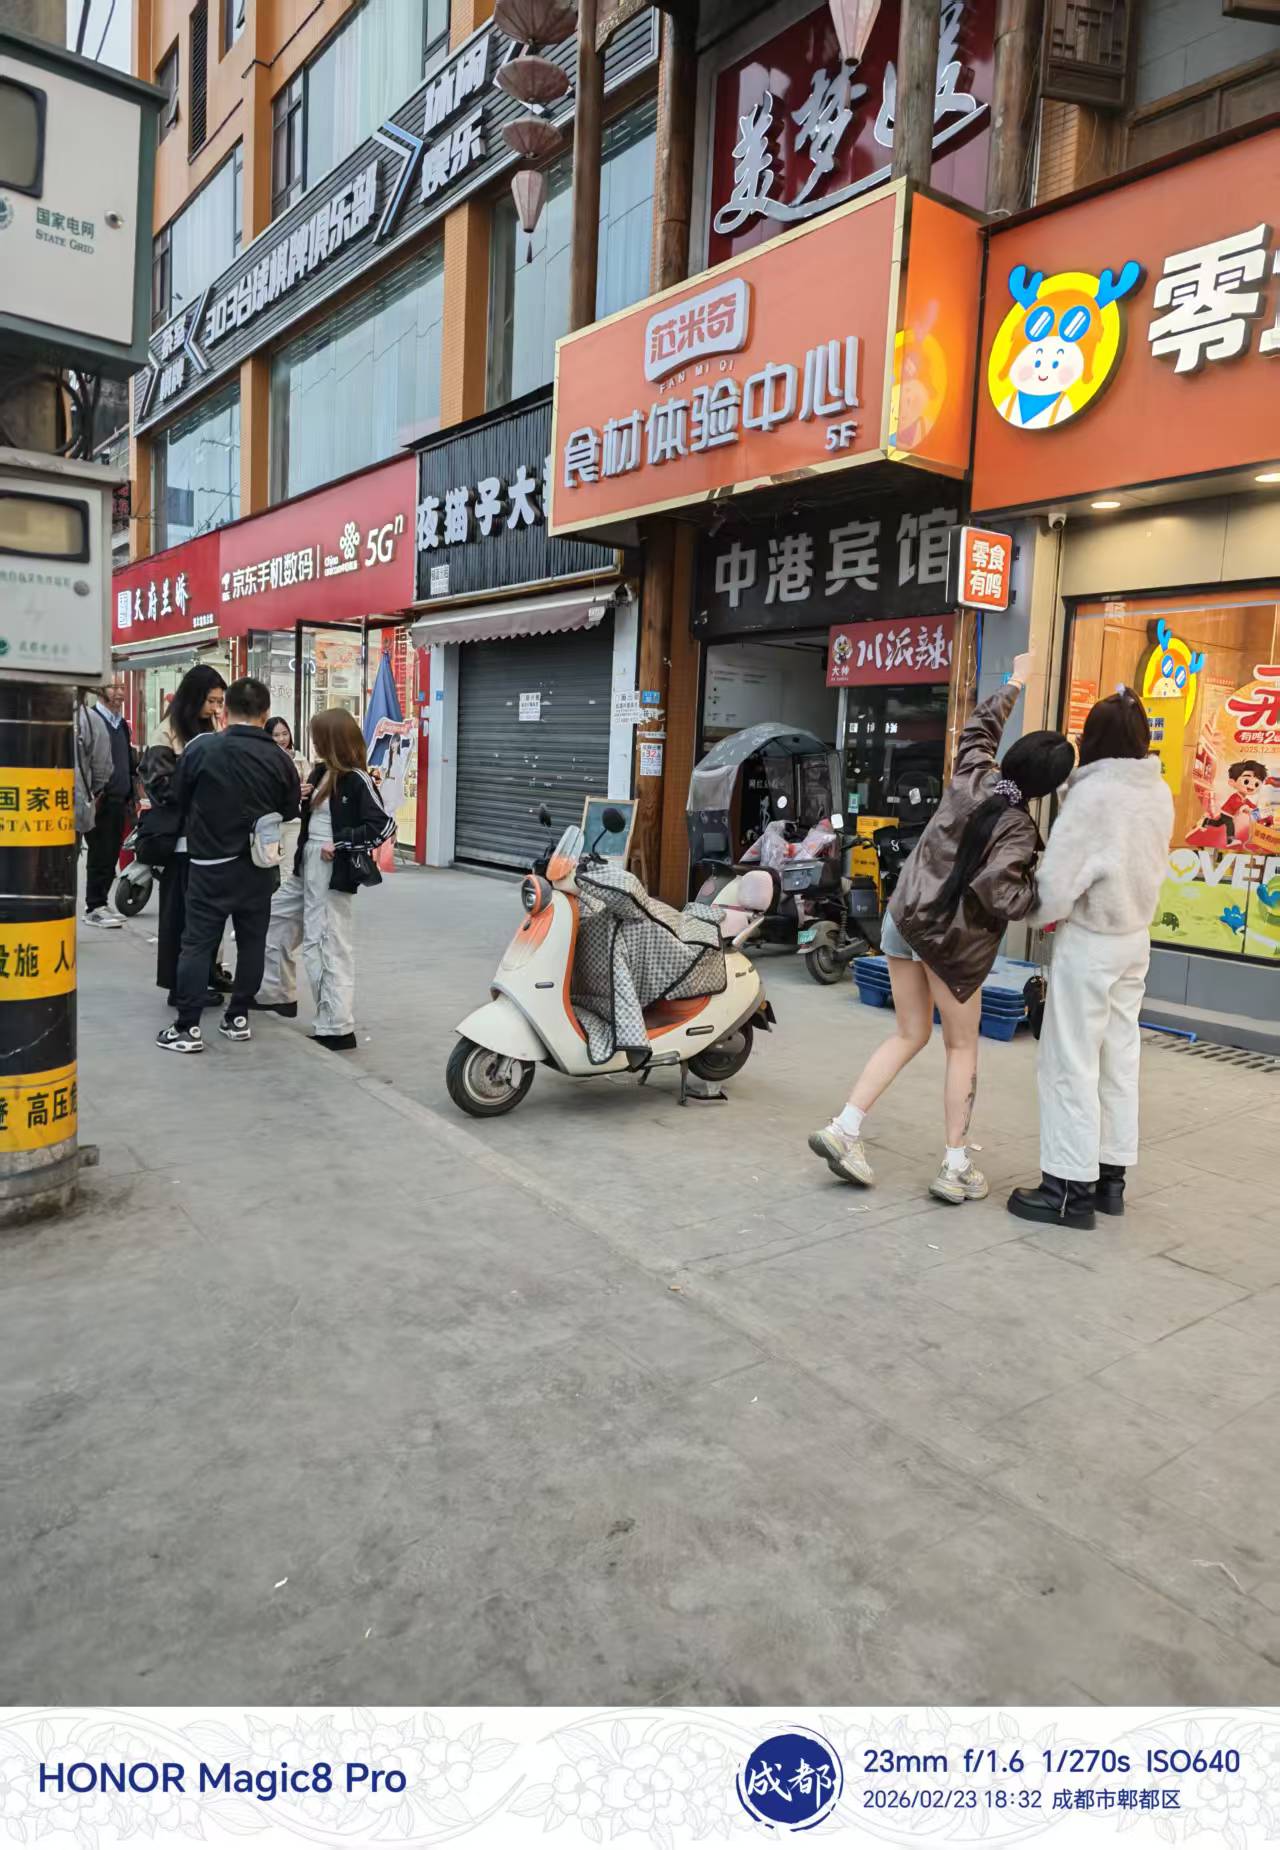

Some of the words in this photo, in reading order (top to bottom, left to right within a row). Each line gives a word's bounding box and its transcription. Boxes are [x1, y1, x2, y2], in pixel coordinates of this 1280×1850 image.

[418, 107, 483, 203] 娱乐
[35, 228, 67, 247] STATE
[69, 239, 95, 255] GRID
[36, 206, 95, 240] 国家电网
[1147, 222, 1280, 374] 零
[650, 293, 736, 364] 范米奇
[660, 372, 686, 394] FAN
[695, 361, 710, 377] MI
[564, 336, 858, 488] 食材体验中心
[825, 420, 857, 450] 5F
[416, 453, 551, 551] 夜猫子大
[232, 547, 313, 600] 京东手机数码
[714, 508, 957, 608] 中港宾馆
[972, 539, 1005, 572] 零食
[969, 569, 1002, 599] 有鸣
[857, 624, 953, 672] 川派辣
[0, 786, 75, 812] 国家电
